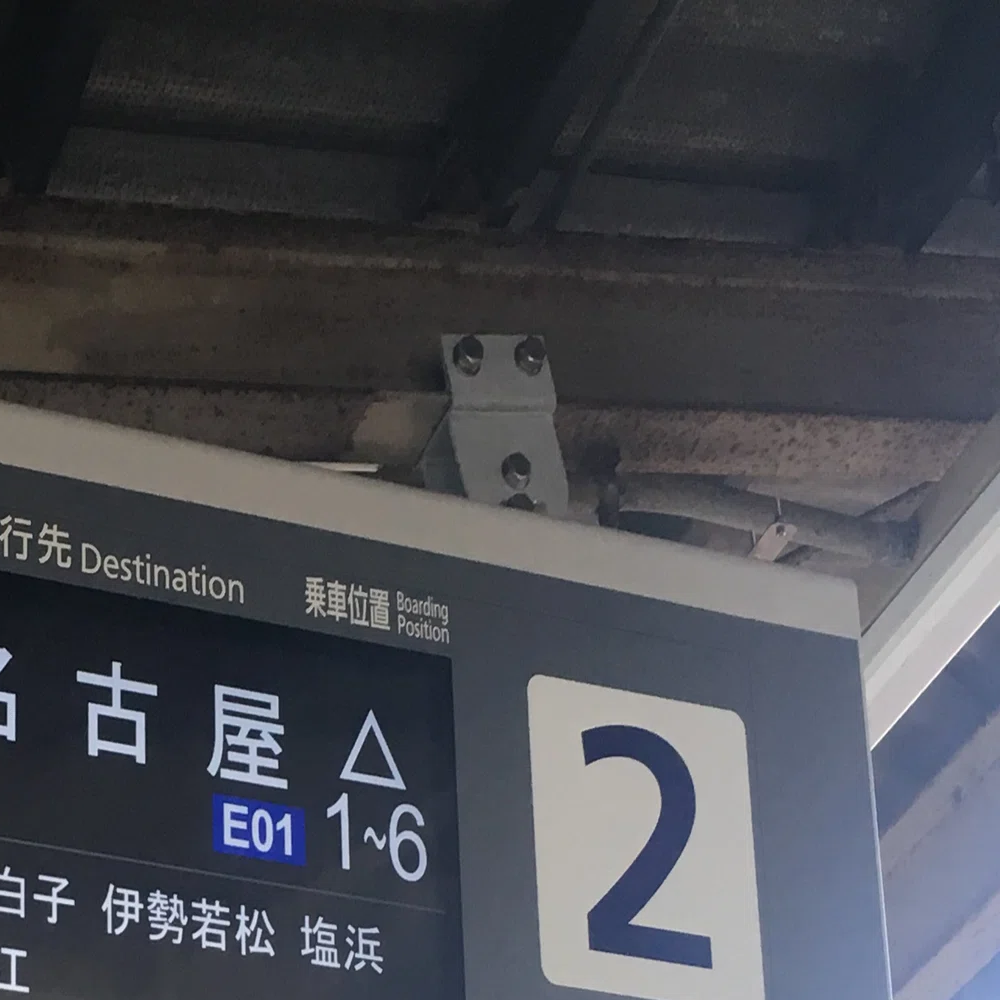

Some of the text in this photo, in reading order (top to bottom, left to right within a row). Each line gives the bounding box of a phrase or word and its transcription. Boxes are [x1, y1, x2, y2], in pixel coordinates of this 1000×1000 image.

[0, 514, 72, 569] 行先
[80, 542, 246, 605] Destination
[304, 576, 391, 632] 乗車位置
[396, 590, 449, 627] Boarding
[397, 614, 450, 645] Position
[222, 804, 293, 857] E01
[581, 724, 713, 970] 2
[101, 882, 276, 958] 伊勢若松
[300, 915, 384, 975] 塩浜
